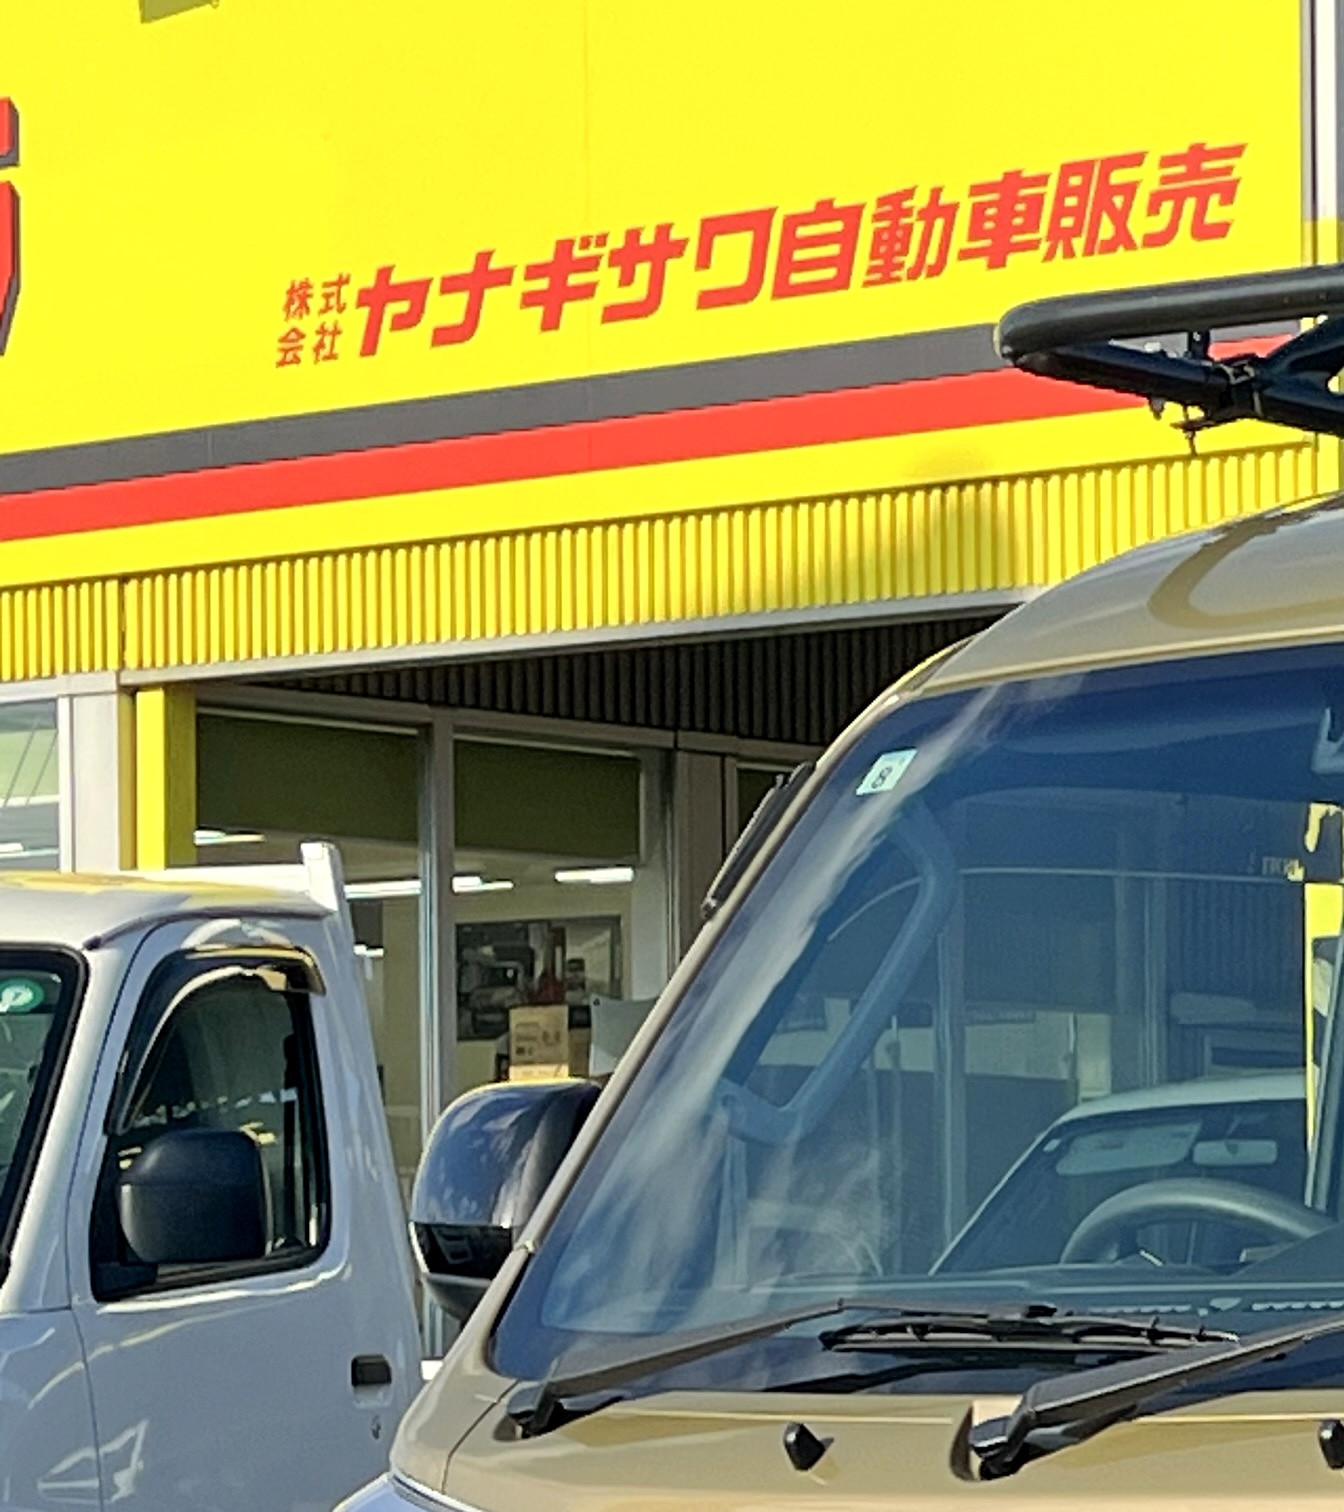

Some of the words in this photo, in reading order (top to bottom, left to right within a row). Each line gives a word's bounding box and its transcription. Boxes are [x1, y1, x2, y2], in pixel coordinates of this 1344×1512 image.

[356, 143, 1247, 357] ヤナギサワ自動車販売
[283, 272, 350, 321] 株式
[276, 320, 342, 367] 会社
